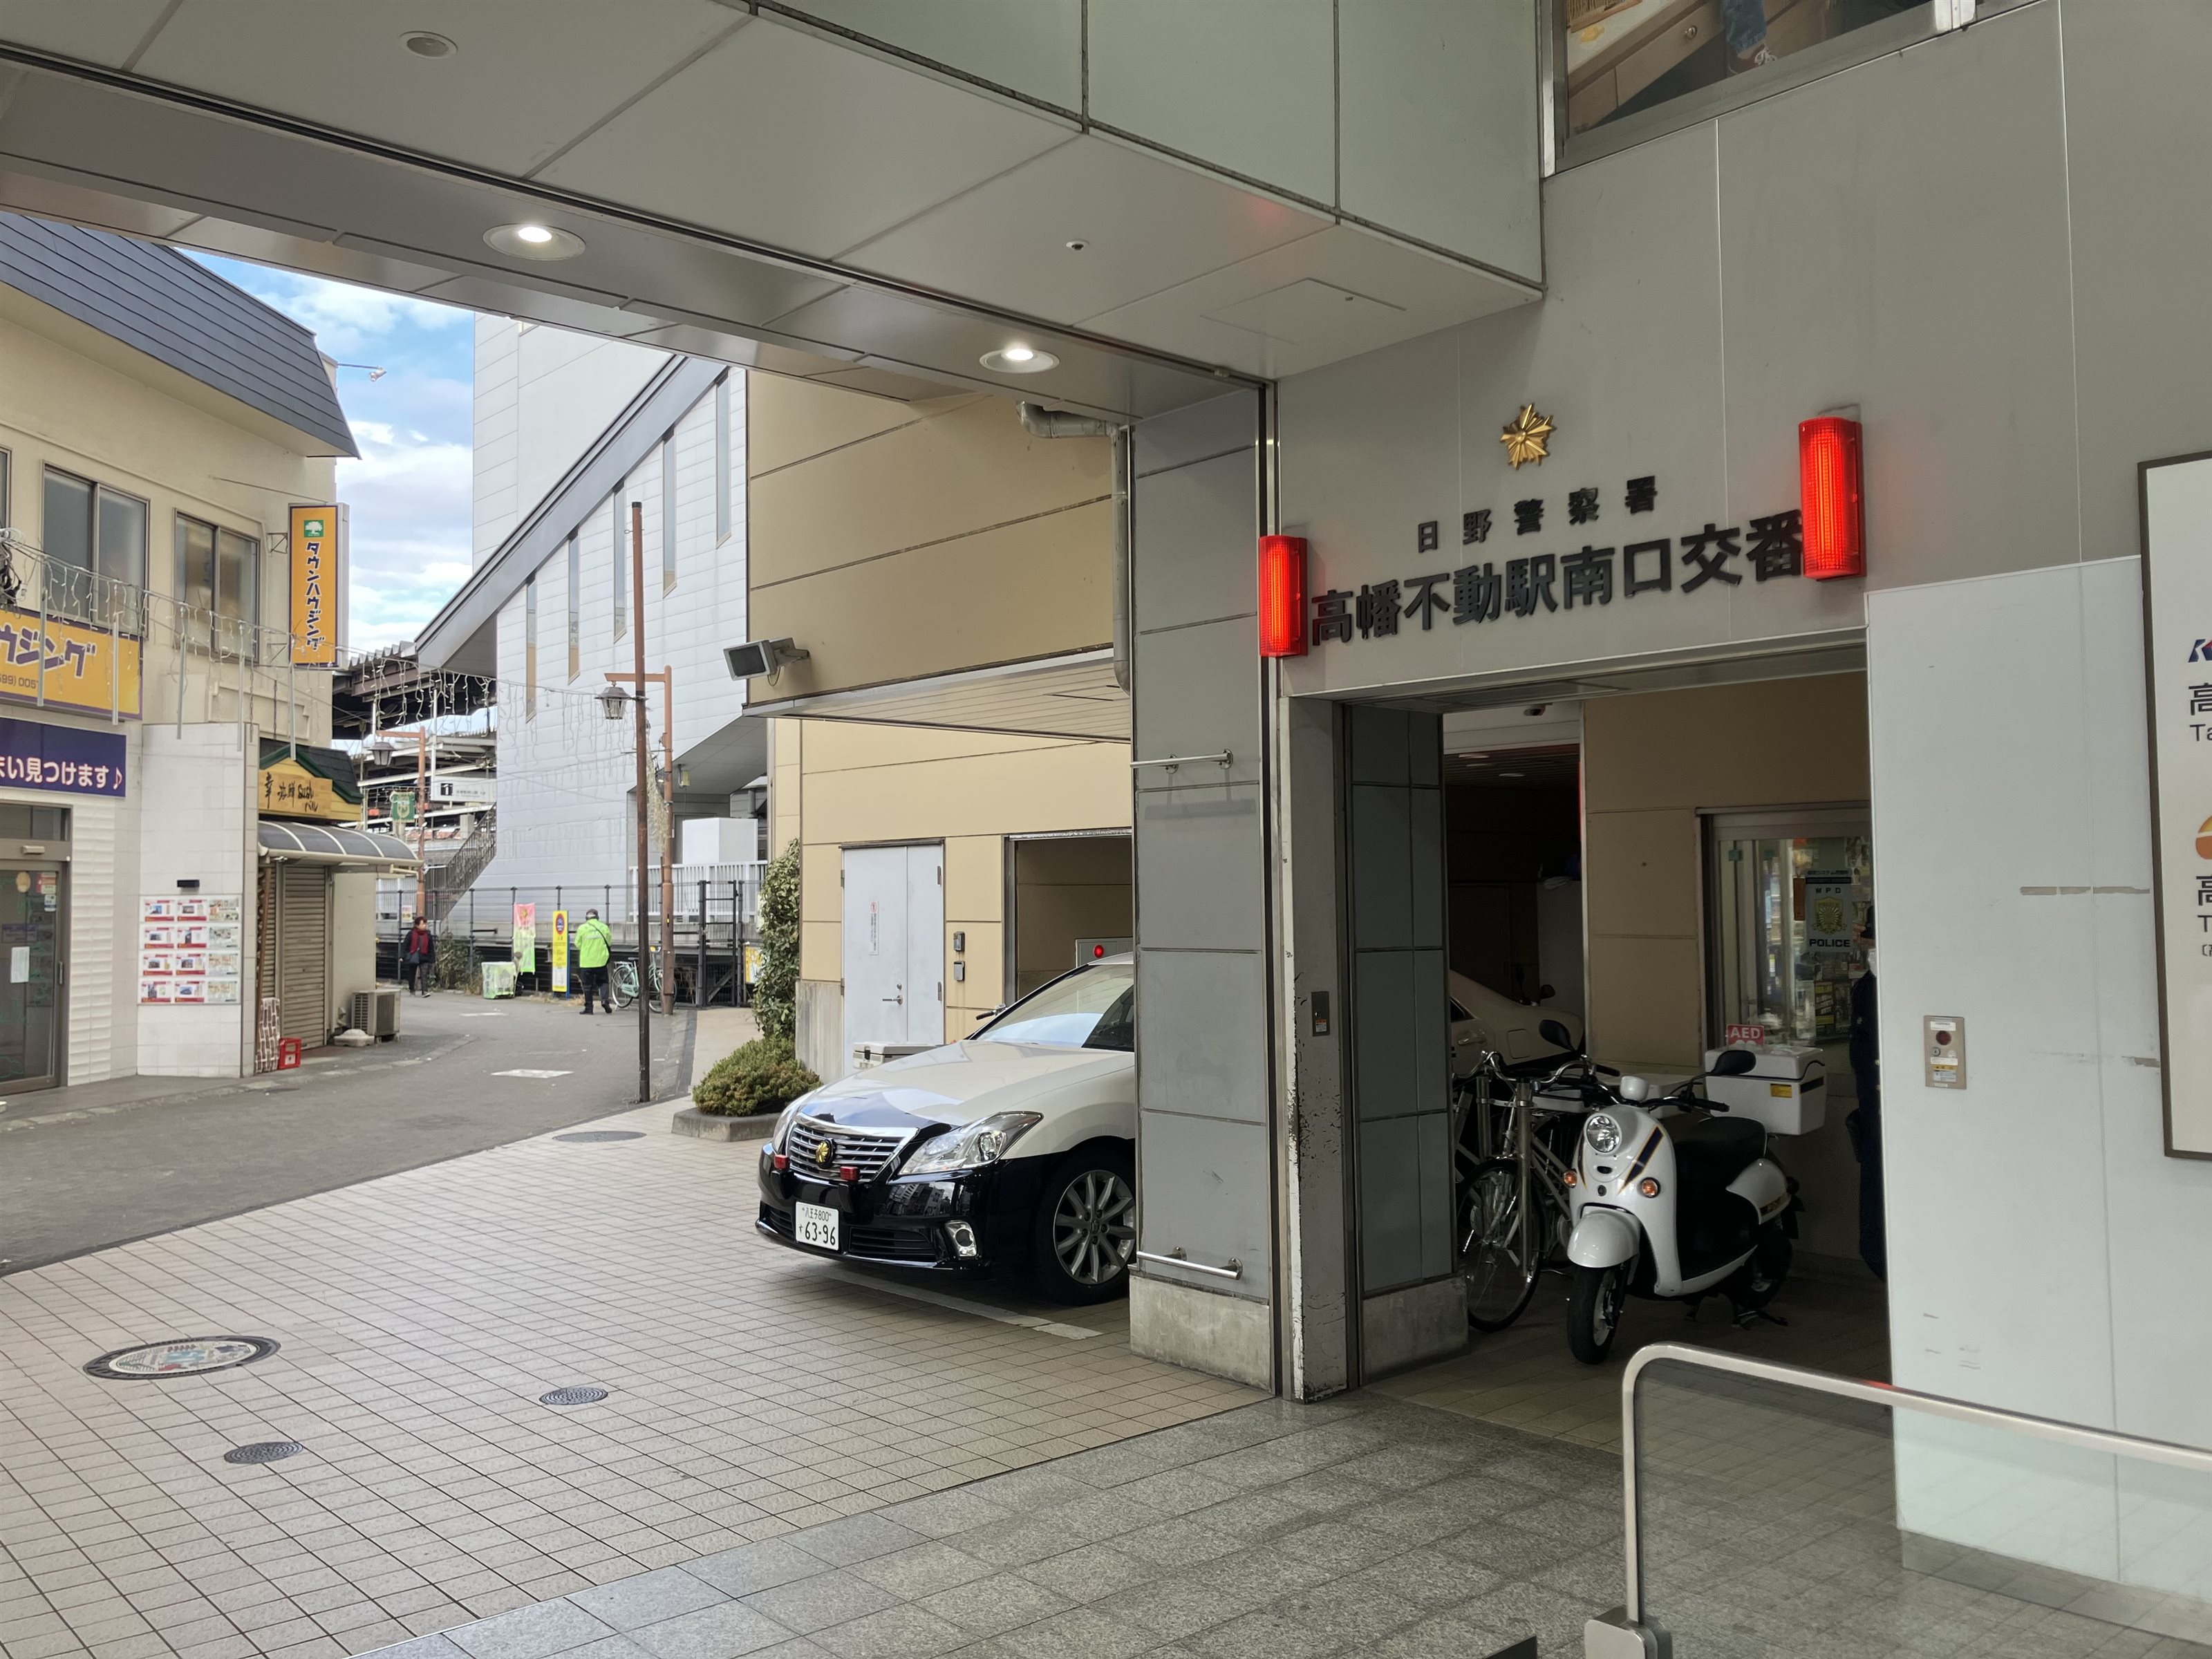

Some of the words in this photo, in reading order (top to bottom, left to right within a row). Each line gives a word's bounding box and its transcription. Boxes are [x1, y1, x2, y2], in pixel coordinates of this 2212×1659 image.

[1417, 476, 1658, 552] 日野警察署
[306, 542, 324, 650] タウンハウジング
[1311, 509, 1803, 646] 高幡不動駅南口交番
[1809, 939, 1850, 948] POLICE
[1730, 1027, 1761, 1040] AED
[805, 1221, 836, 1246] 63-96
